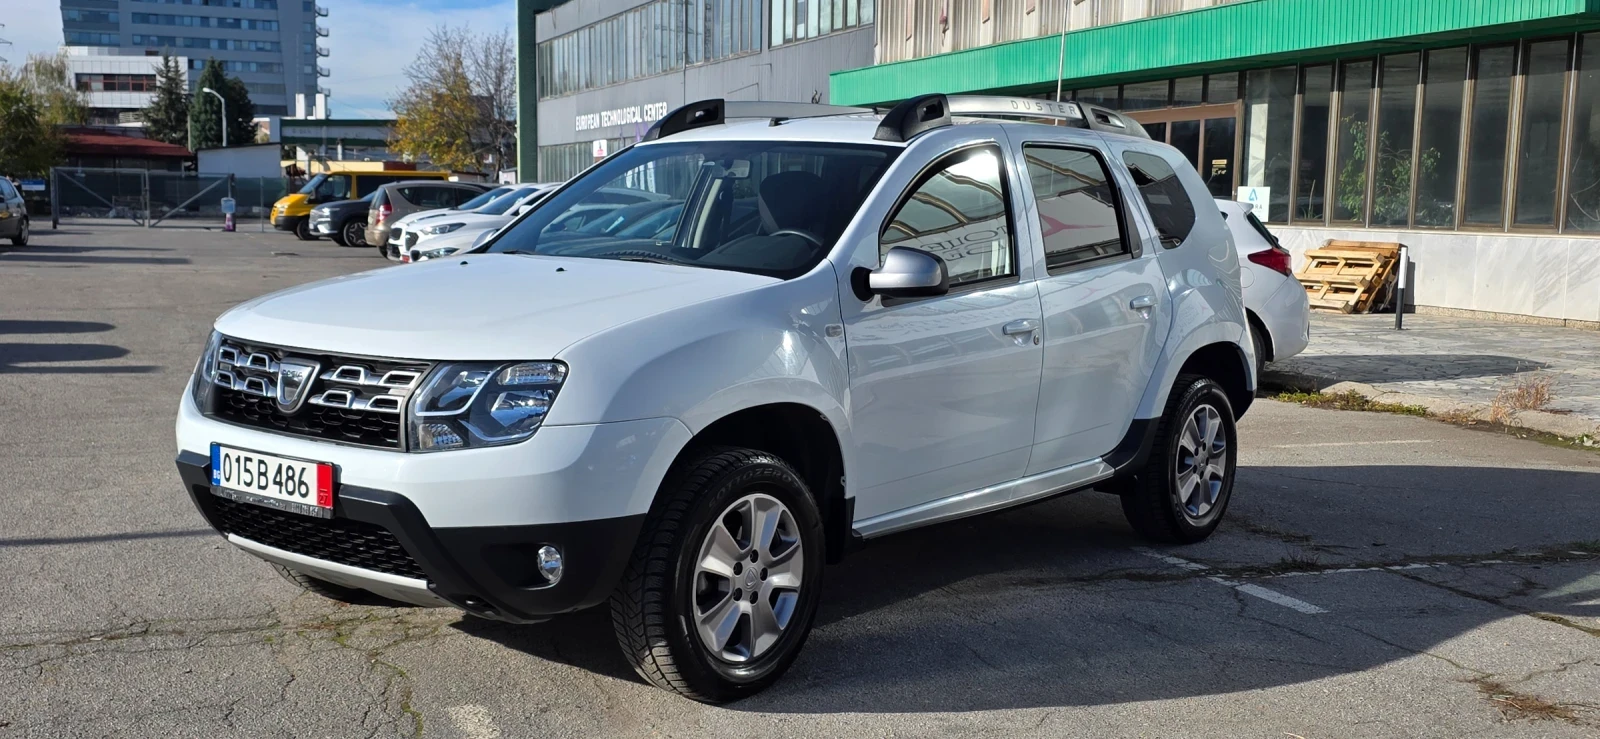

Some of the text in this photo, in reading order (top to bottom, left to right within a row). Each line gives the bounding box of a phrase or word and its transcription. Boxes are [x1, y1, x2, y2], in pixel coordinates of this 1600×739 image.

[575, 102, 667, 131] EUROPEAN TECHNOLOGICAL CENTER
[1010, 100, 1076, 115] DUSTER
[213, 469, 221, 480] BG
[223, 452, 309, 498] 015B486
